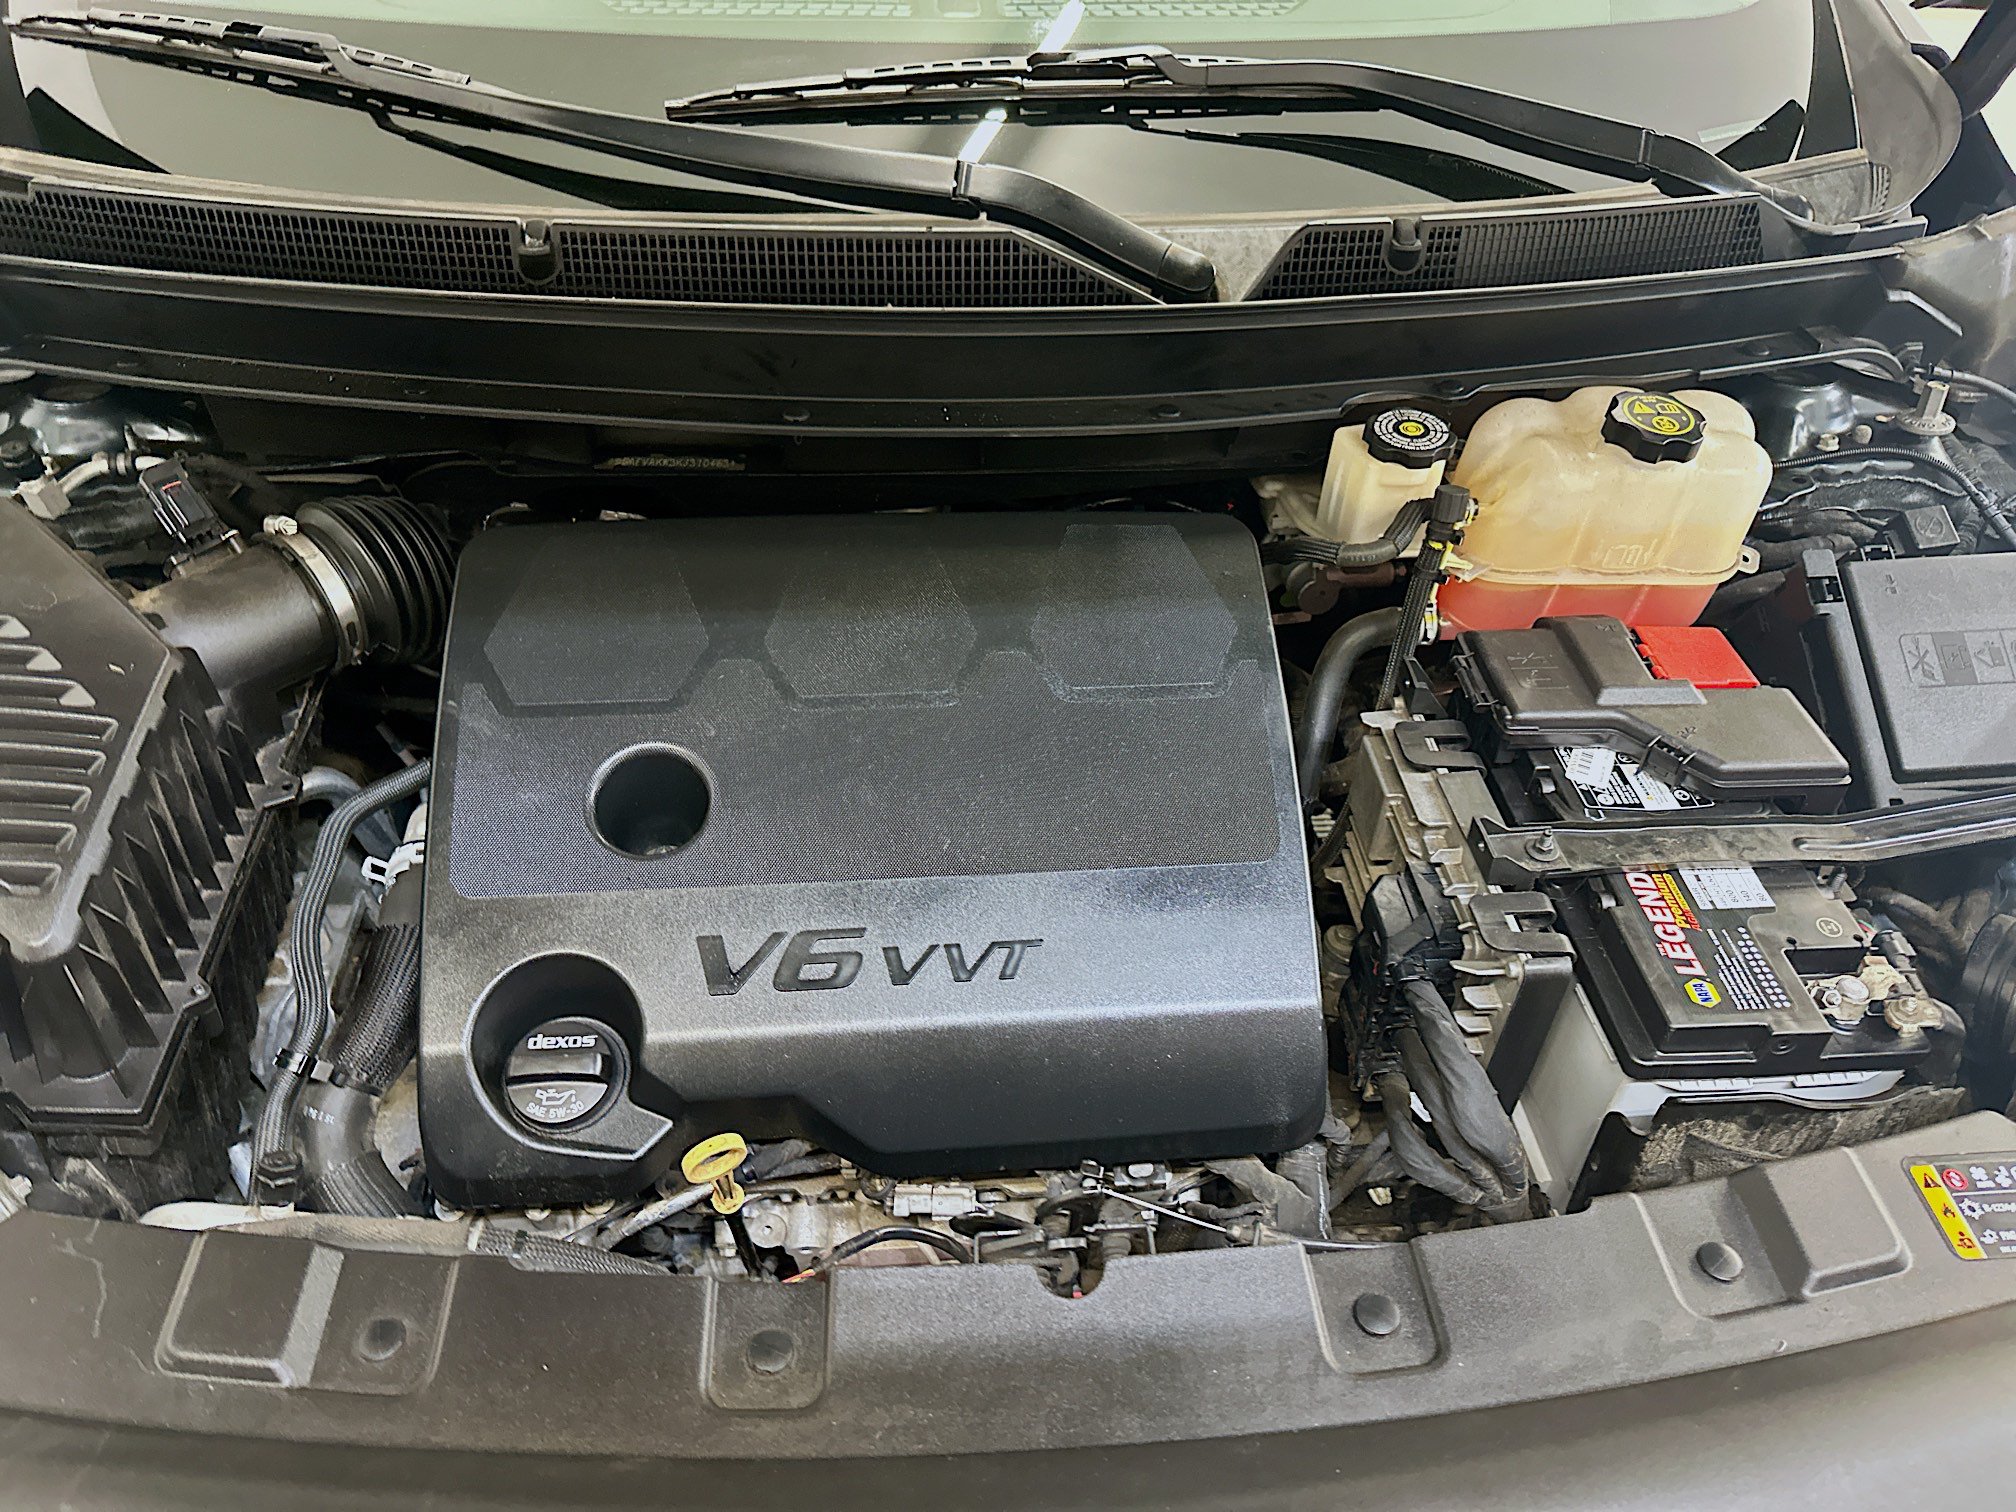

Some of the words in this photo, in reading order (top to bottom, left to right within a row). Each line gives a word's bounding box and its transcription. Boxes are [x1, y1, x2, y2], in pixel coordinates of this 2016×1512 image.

[1651, 873, 1692, 929] Premium
[1625, 870, 1707, 977] LEGEND
[696, 927, 867, 996] V6
[882, 938, 1044, 985] VVT
[1692, 983, 1714, 1004] NAPA
[527, 1033, 598, 1050] dexos
[526, 1102, 547, 1118] SAE
[549, 1100, 585, 1119] 5W-30
